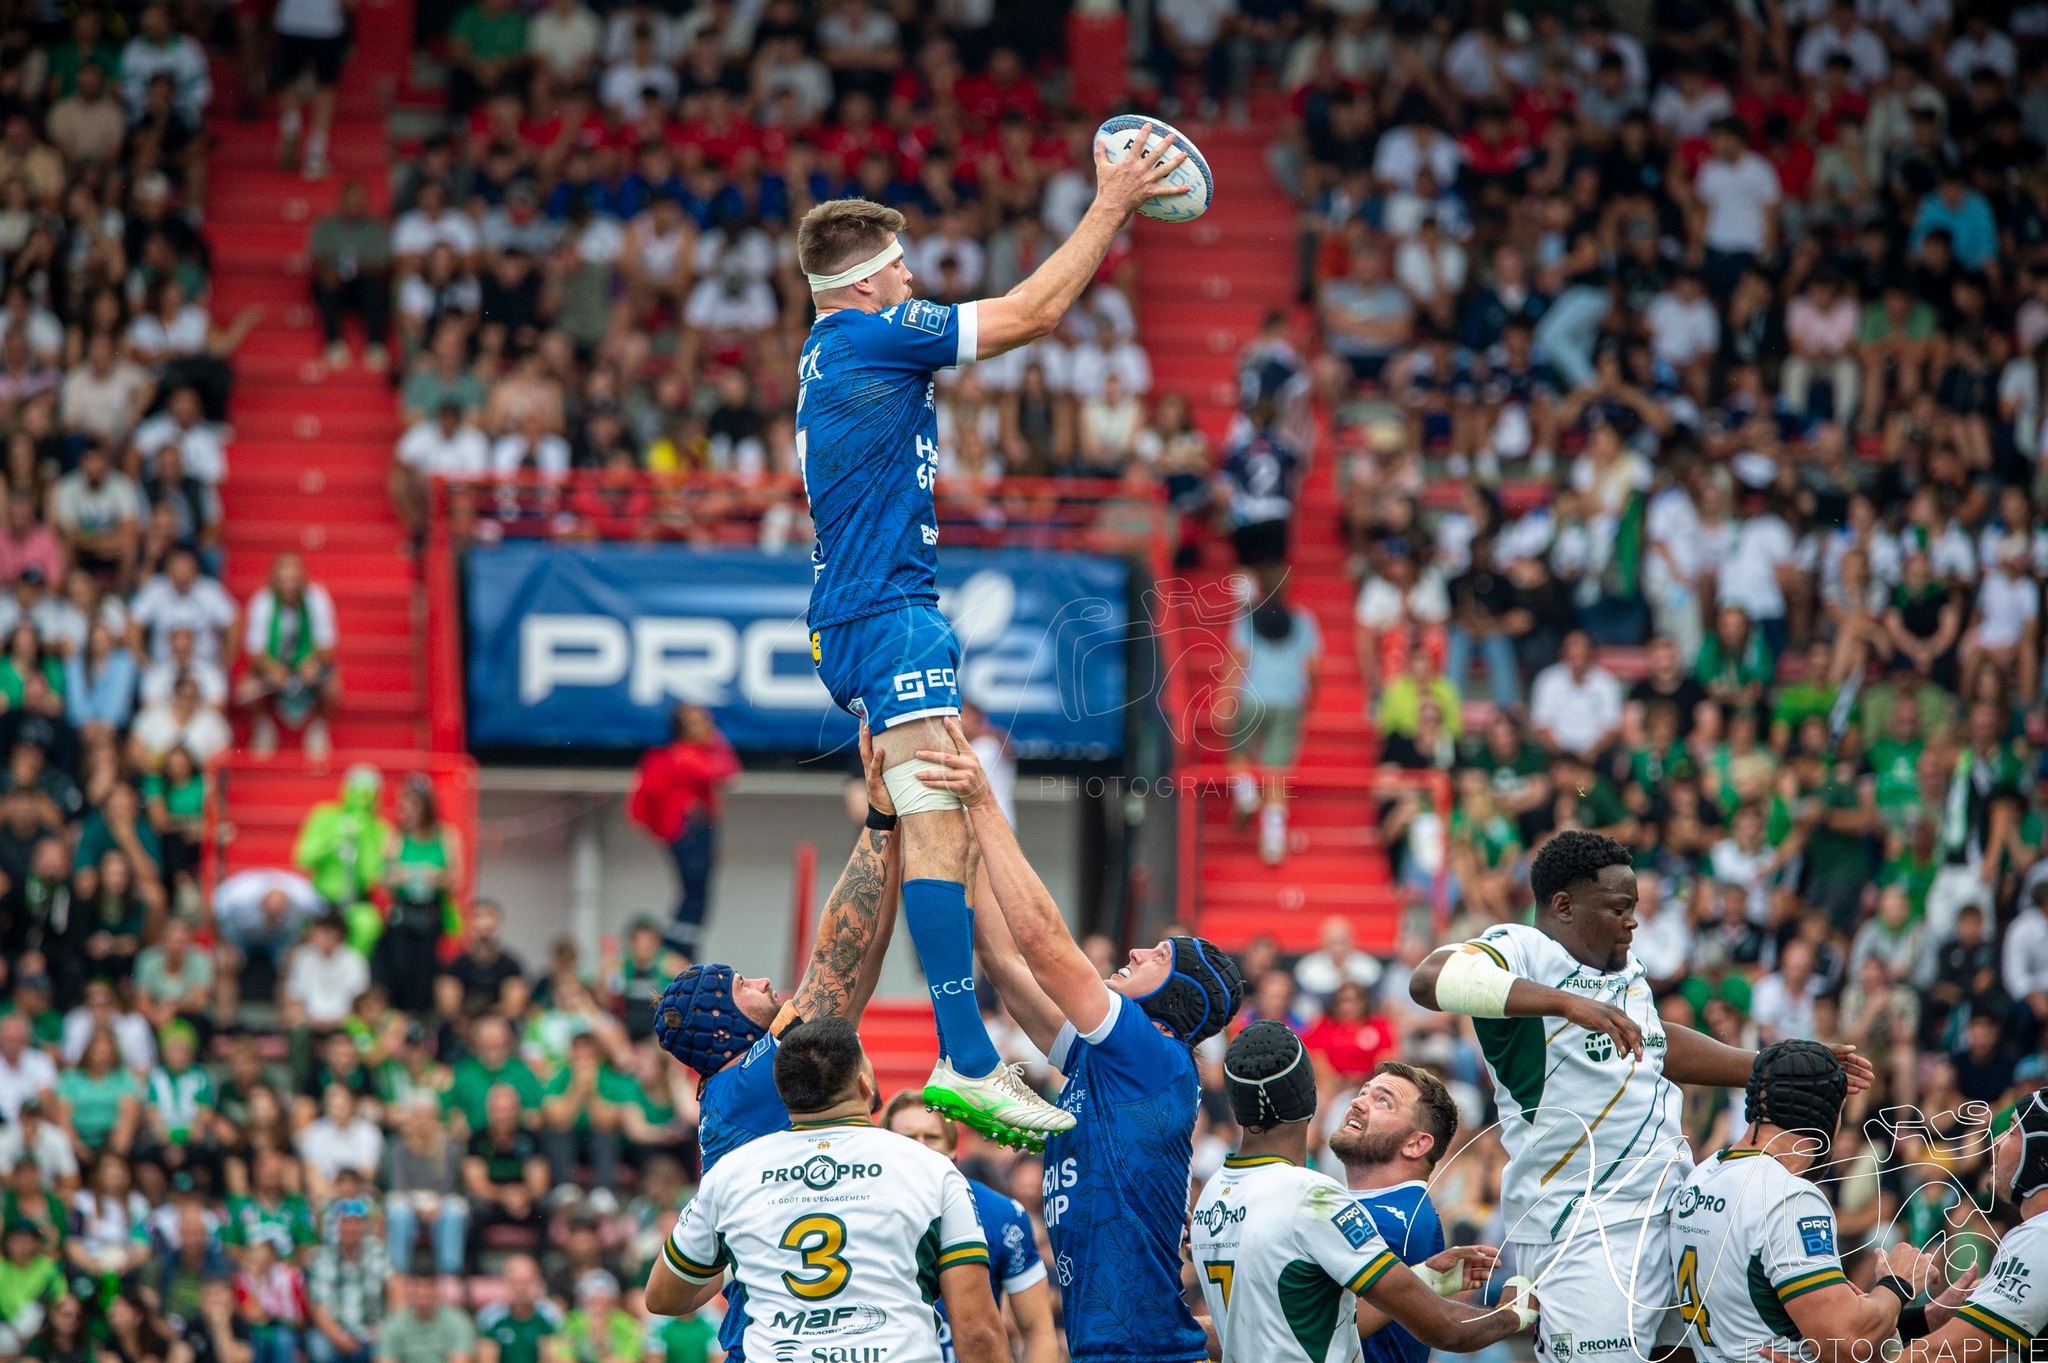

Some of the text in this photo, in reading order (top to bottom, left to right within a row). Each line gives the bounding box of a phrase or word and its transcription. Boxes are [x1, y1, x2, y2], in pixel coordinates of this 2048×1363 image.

[908, 302, 922, 323] PRO
[1337, 1207, 1361, 1226] PRO
[1801, 1220, 1830, 1231] PRO
[1348, 1222, 1375, 1245] D2
[778, 1213, 853, 1301] 3
[1807, 1239, 1833, 1253] D2
[1203, 1260, 1235, 1313] 7
[1677, 1245, 1717, 1347] 4
[1997, 1275, 2032, 1299] ETC
[811, 1345, 888, 1363] saur
